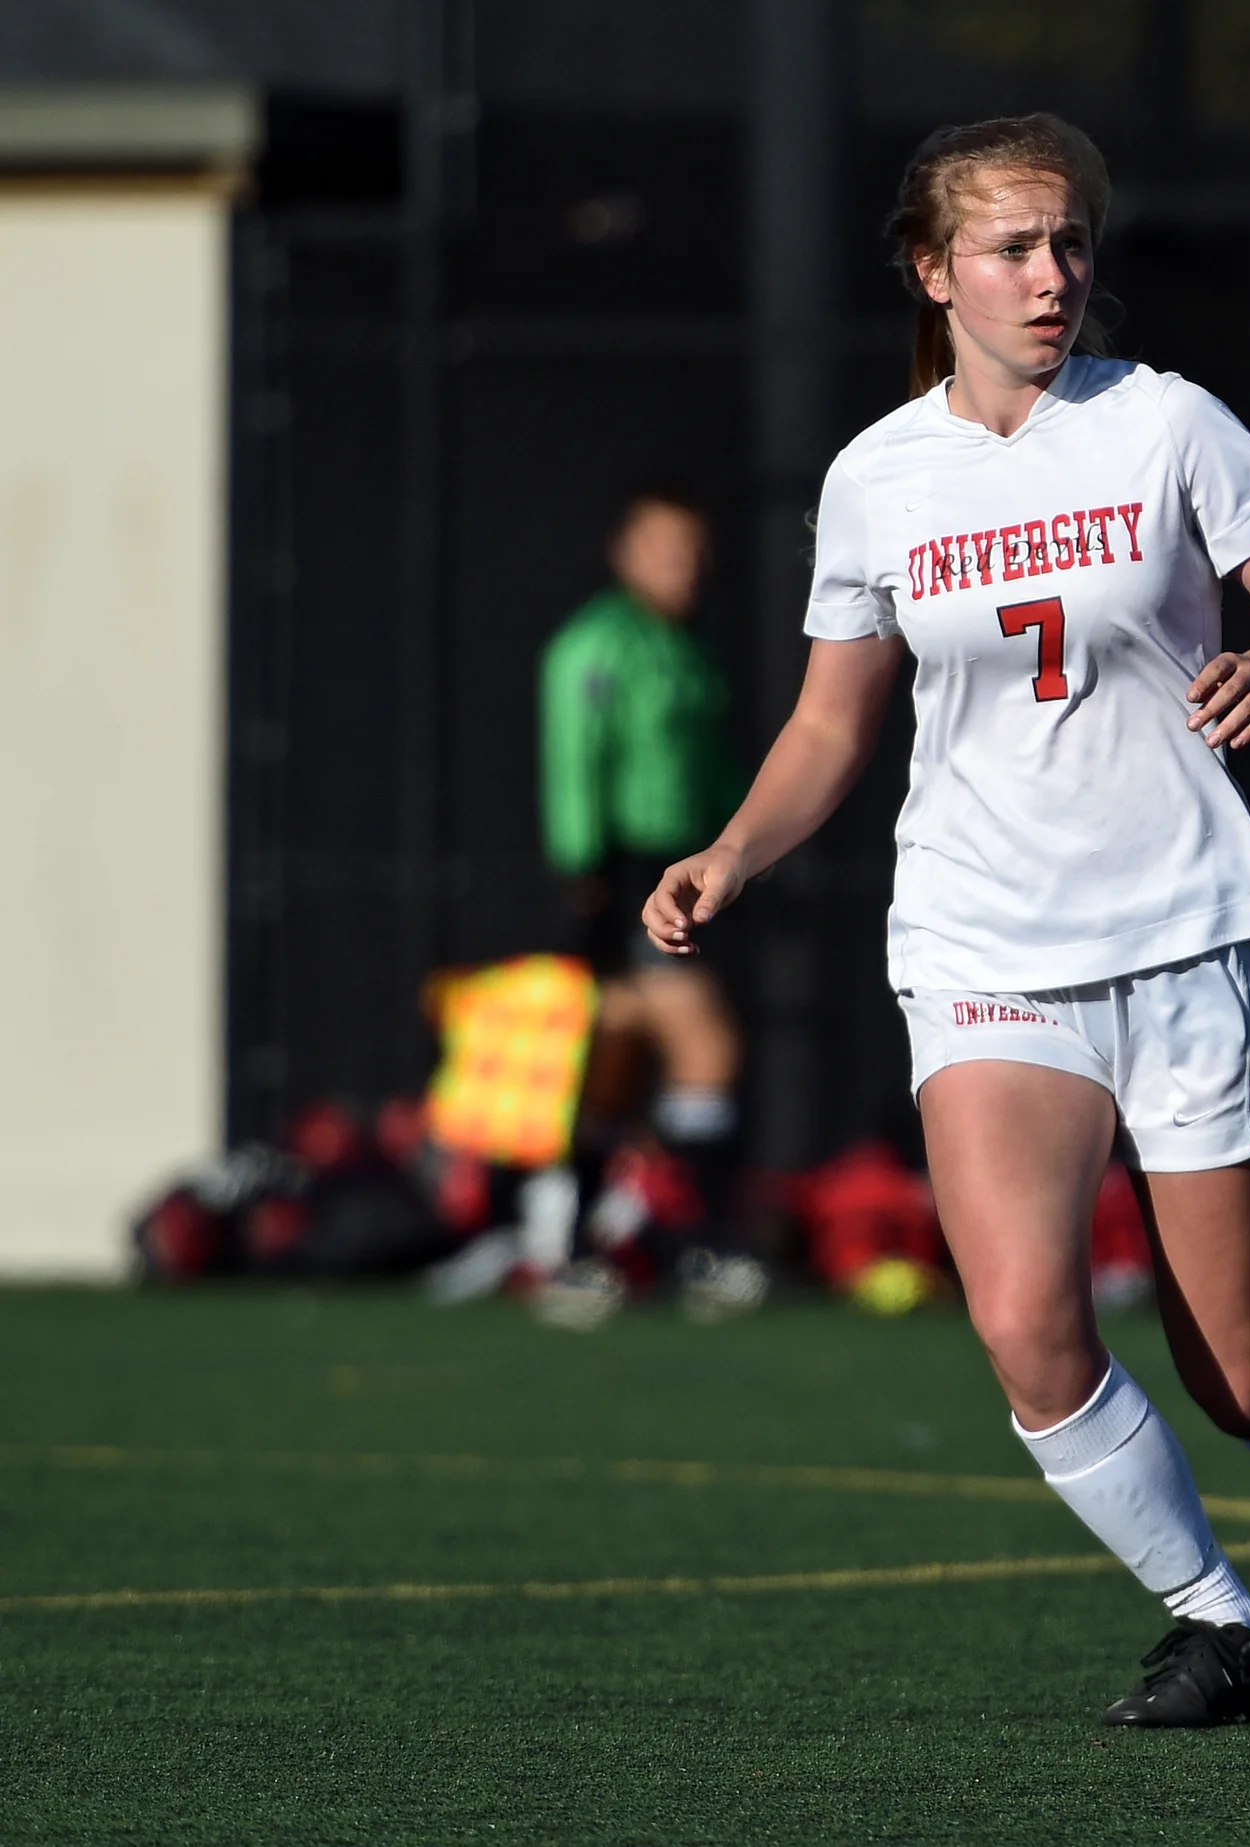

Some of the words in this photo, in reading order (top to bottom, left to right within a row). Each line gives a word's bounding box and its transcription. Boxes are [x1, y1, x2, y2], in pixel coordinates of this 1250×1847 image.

[908, 502, 1143, 600] UNIVERSITY
[936, 542, 1001, 580] Red
[1005, 524, 1106, 566] Devils
[996, 595, 1068, 703] 7
[953, 1001, 1058, 1025] UNIVER
